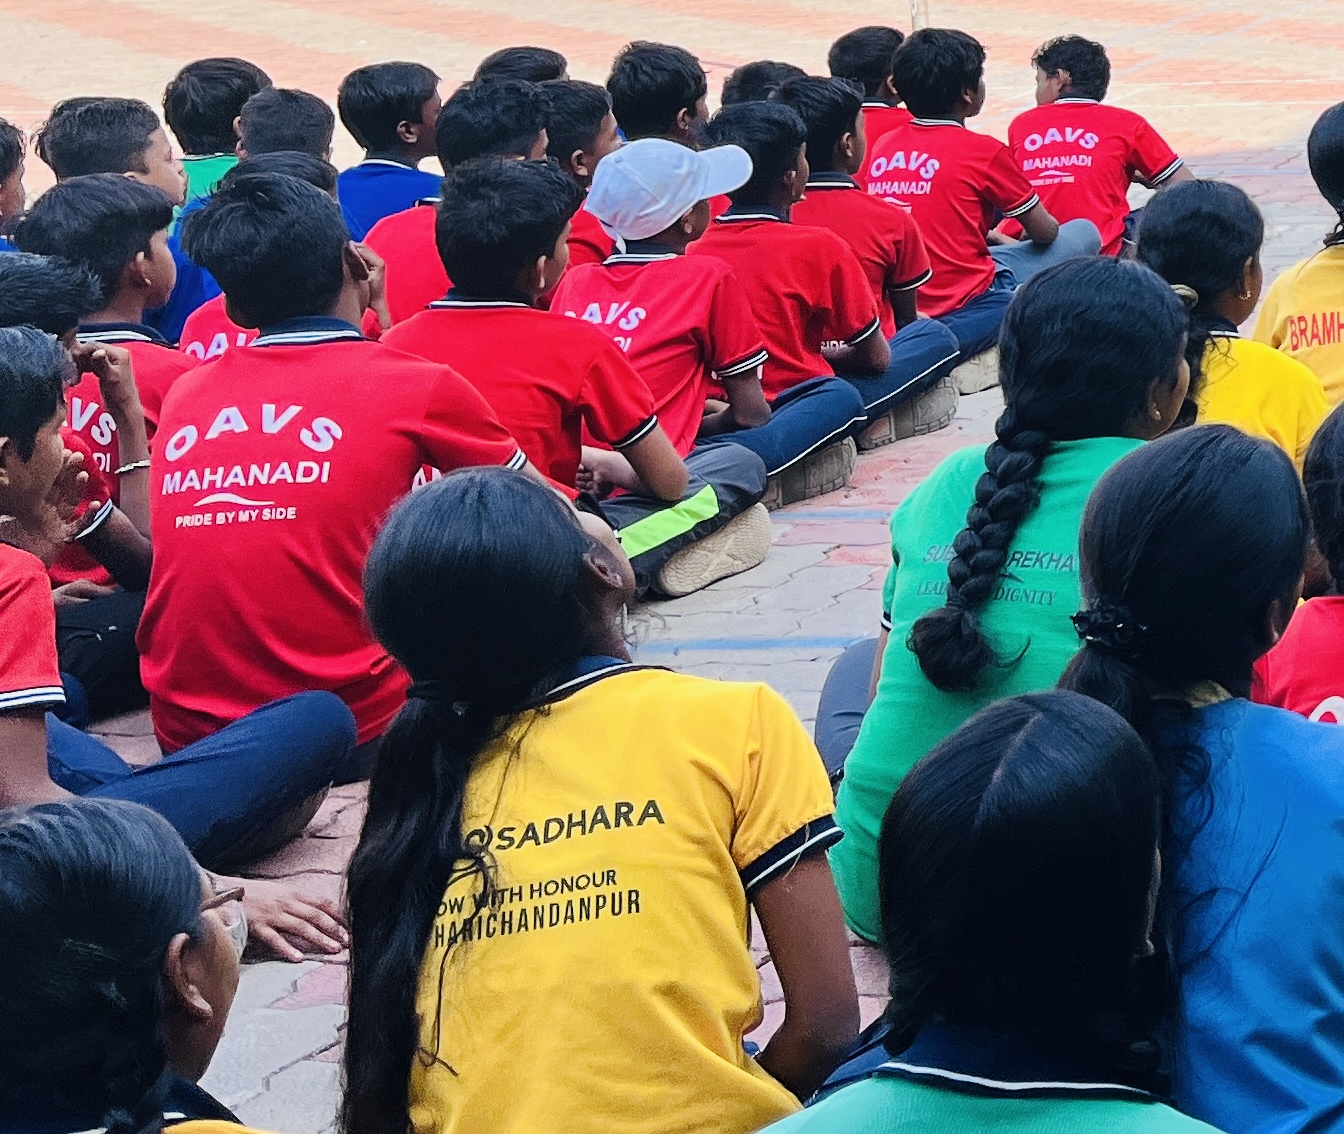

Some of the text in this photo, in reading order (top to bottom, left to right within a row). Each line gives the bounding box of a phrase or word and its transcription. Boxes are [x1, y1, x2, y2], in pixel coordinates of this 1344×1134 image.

[1023, 127, 1099, 152] OAVS
[870, 151, 940, 180] OAVS
[1023, 155, 1092, 172] MAHANADI
[867, 181, 932, 196] MAHANADI
[564, 301, 648, 331] AVS
[71, 397, 116, 446] VS
[165, 403, 343, 462] OAVS
[162, 461, 331, 496] MAHANADI
[175, 507, 297, 529] PRIDE BY MY SIDE
[993, 586, 1057, 606] DIGNITY
[495, 799, 666, 851] SADHARA
[436, 895, 465, 917] OW
[529, 869, 618, 900] HONOUR
[434, 889, 641, 948] HARICHANDANPUR
